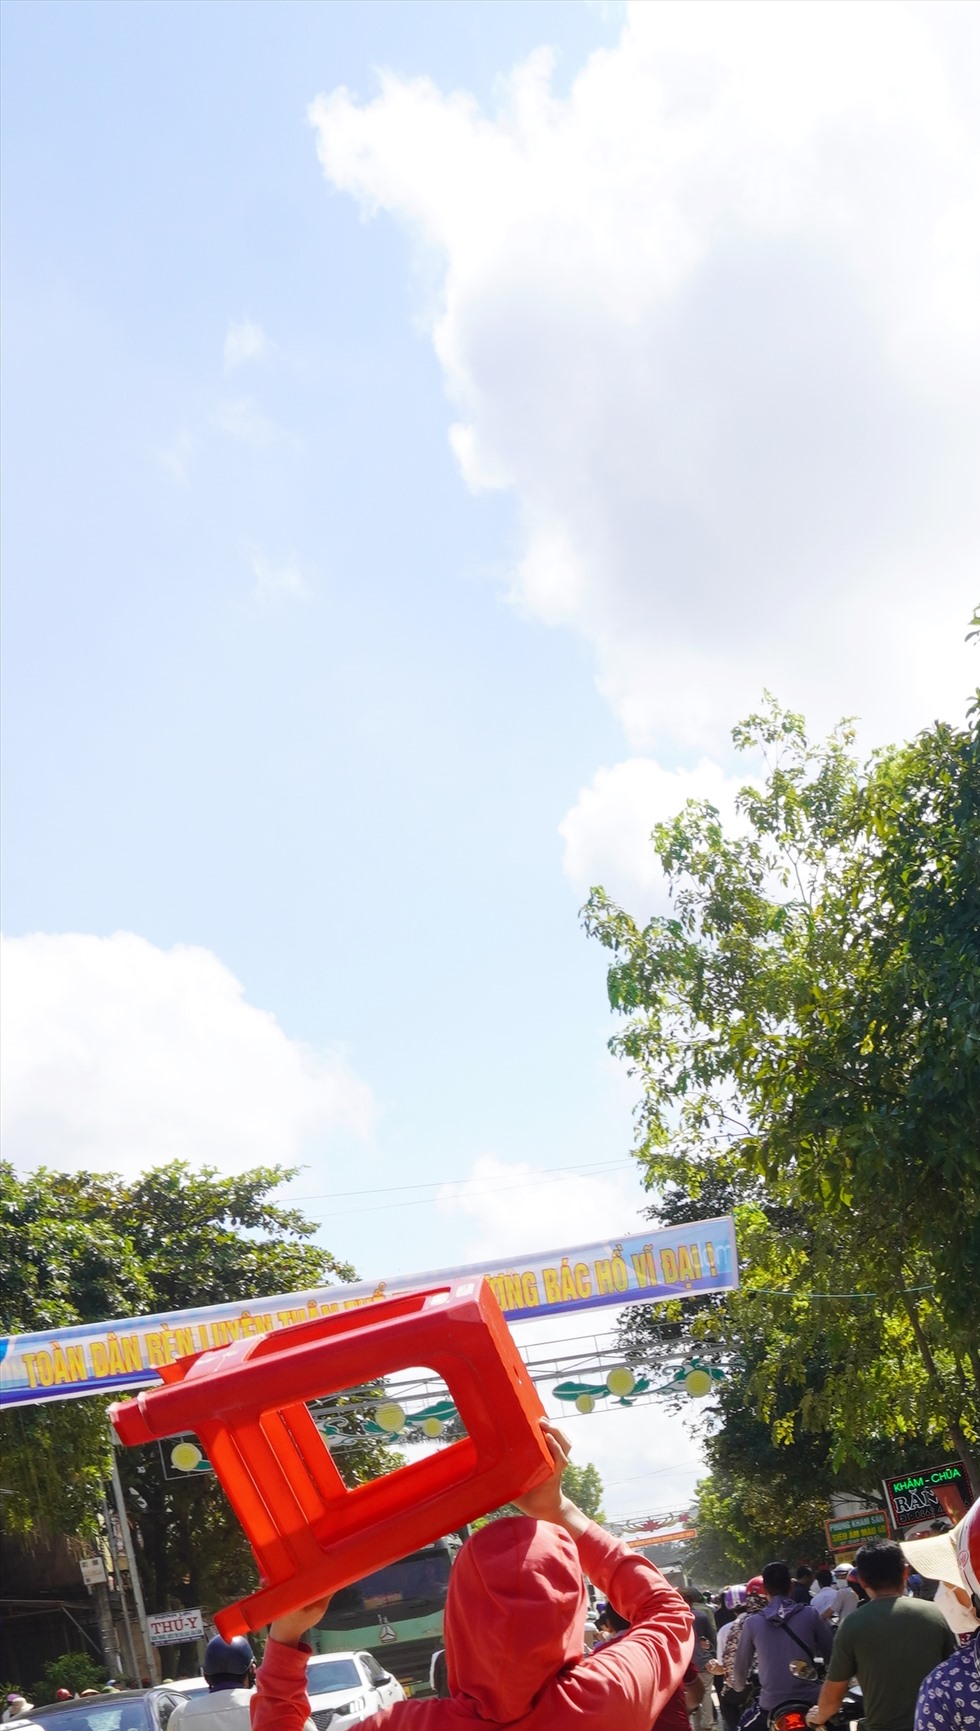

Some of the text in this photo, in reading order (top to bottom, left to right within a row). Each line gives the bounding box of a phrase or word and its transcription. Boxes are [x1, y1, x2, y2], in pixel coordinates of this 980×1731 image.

[21, 1340, 88, 1388] TOÀN
[145, 1322, 194, 1367] RÈN
[542, 1257, 593, 1304] BÁC
[594, 1244, 629, 1296] HỒ
[631, 1243, 657, 1290] VĨ
[659, 1244, 702, 1290] ĐẠI
[893, 1477, 924, 1492] KHÁM
[930, 1469, 961, 1483] CHỮA
[893, 1486, 938, 1514] RĂN
